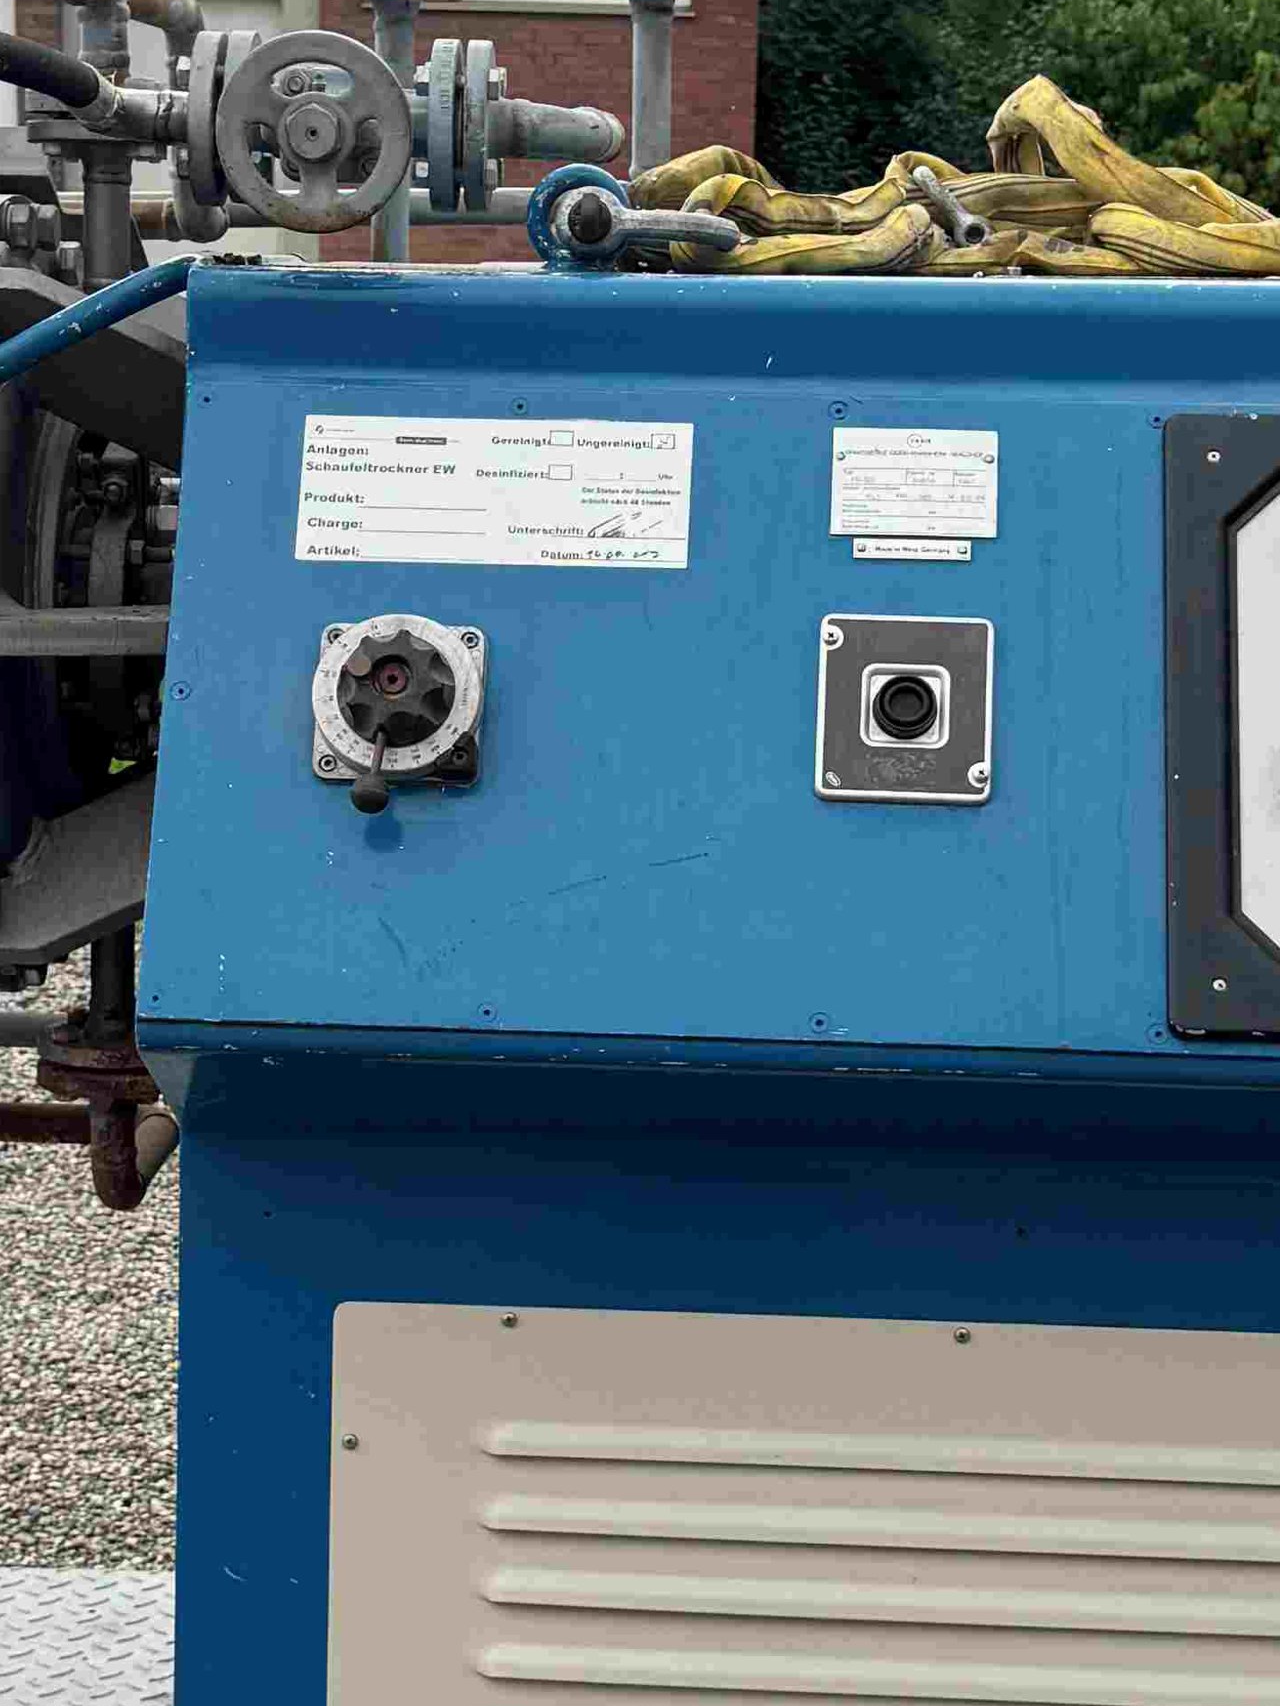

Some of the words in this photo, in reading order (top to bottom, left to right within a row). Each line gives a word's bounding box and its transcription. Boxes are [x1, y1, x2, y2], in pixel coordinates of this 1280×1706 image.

[307, 444, 369, 457] Anlagen:
[306, 461, 429, 474] Schaufeltrockner
[433, 464, 456, 474] EW
[304, 492, 365, 503] Produkt:
[307, 517, 363, 530] Charge:
[508, 525, 584, 536] Unterschrift:
[306, 545, 360, 557] Artikel:
[540, 549, 584, 560] Datum:
